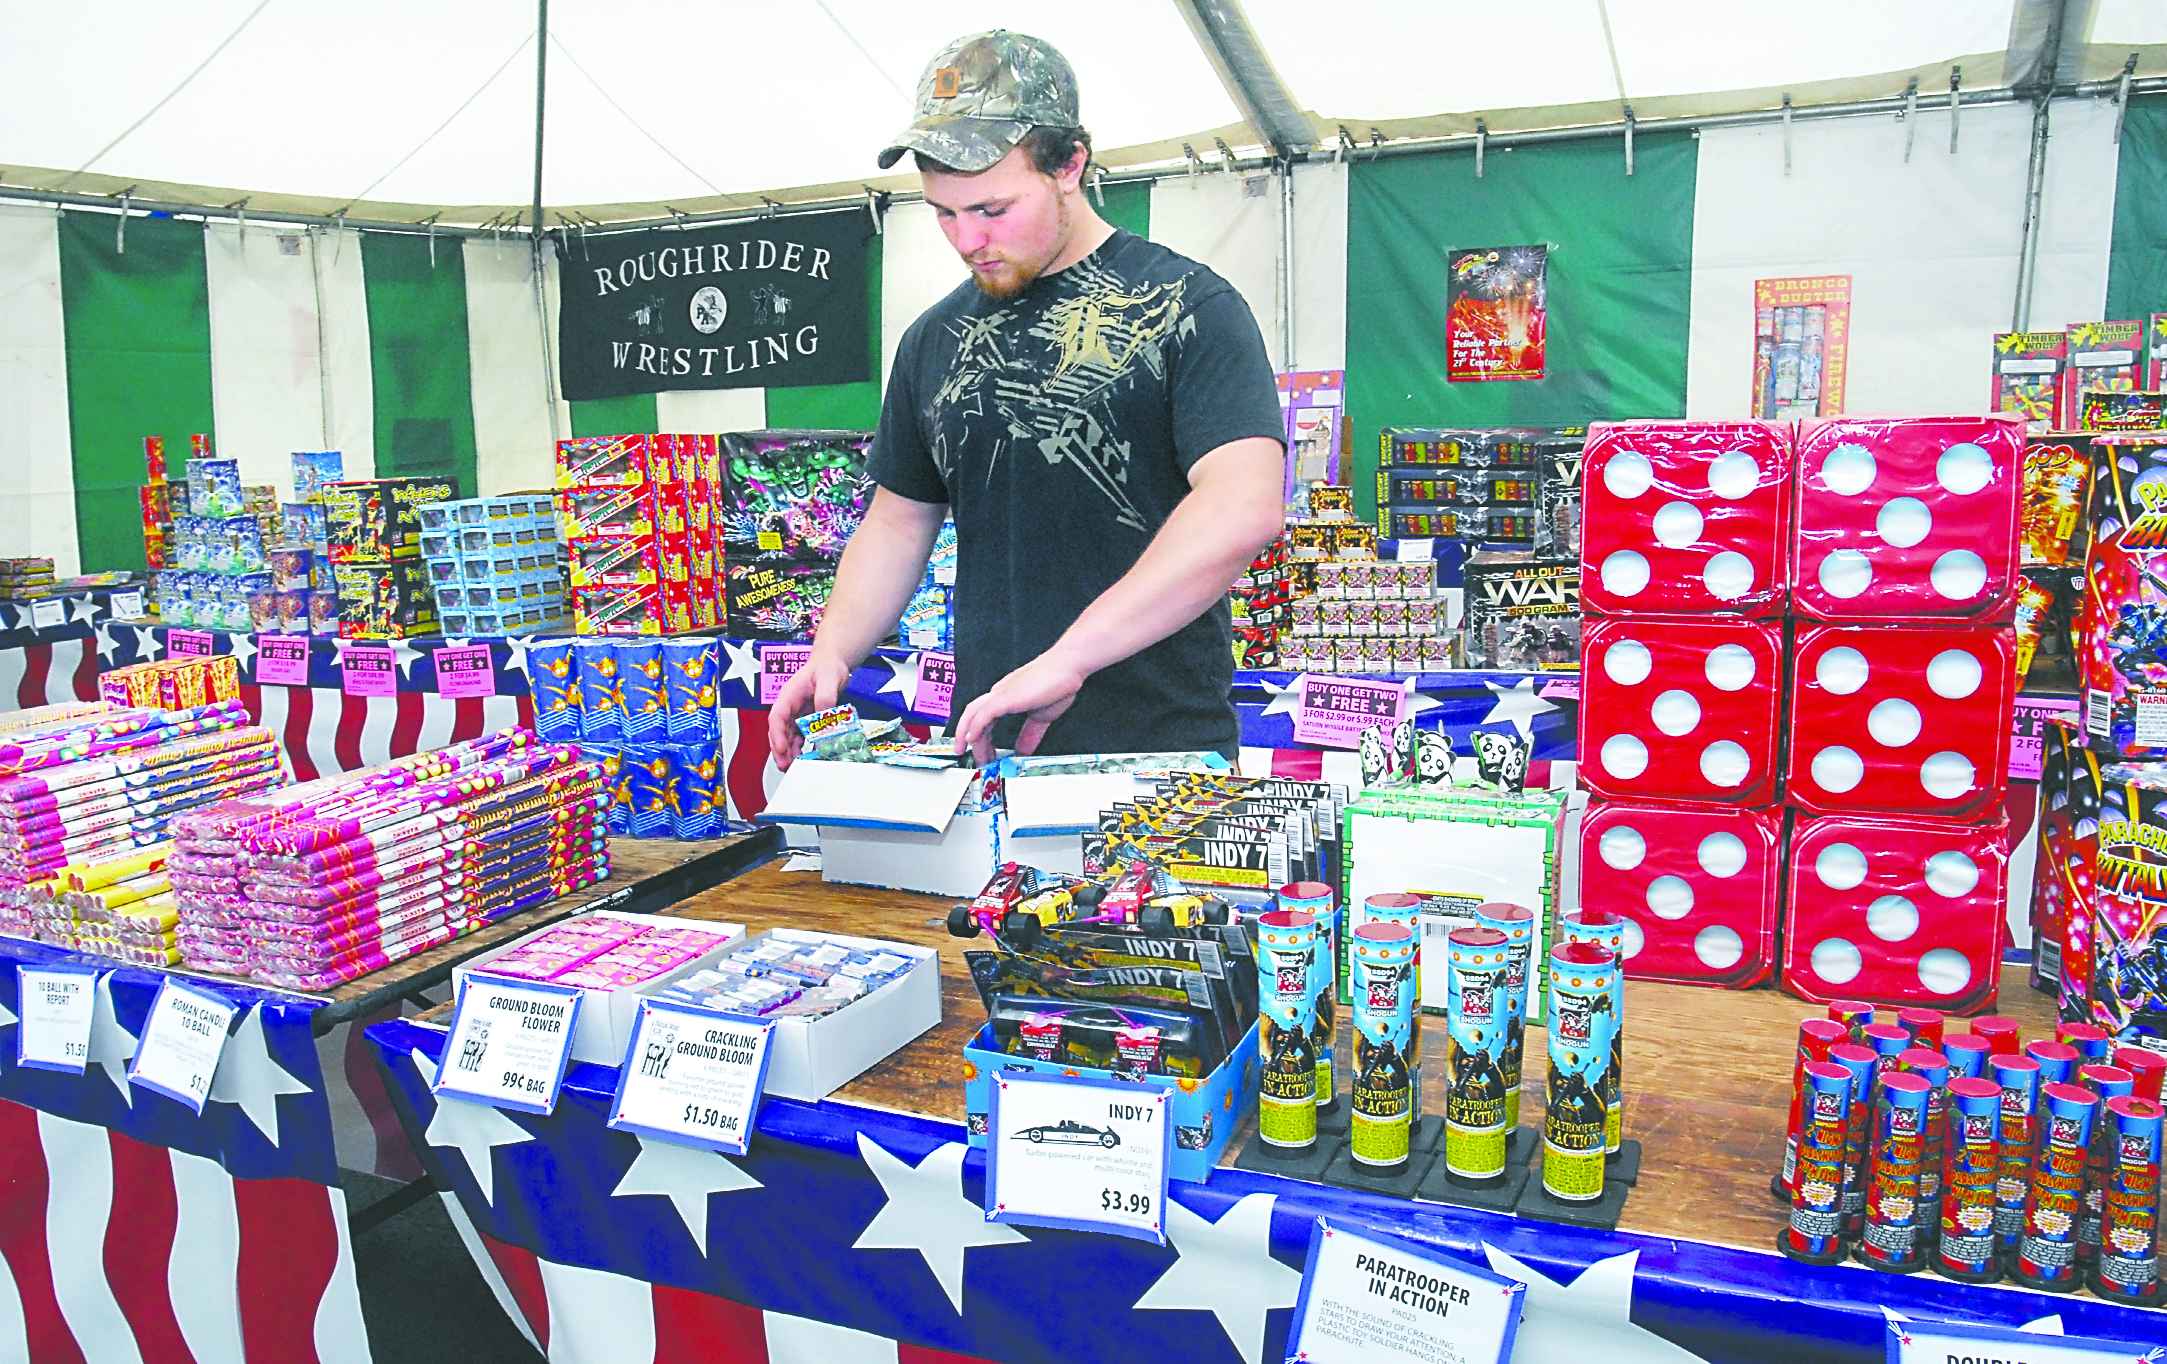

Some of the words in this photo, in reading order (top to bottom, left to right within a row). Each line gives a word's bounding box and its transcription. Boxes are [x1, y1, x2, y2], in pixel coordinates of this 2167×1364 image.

[594, 239, 831, 295] ROUGHRIDER
[1775, 278, 1848, 291] BRONCO
[1780, 292, 1846, 303] BUSTER
[2093, 324, 2139, 333] TIMBER
[2101, 333, 2132, 342] WOLF
[612, 325, 819, 376] WRESTLING
[1453, 340, 1485, 348] Reliable
[1469, 359, 1504, 367] Century
[1826, 344, 1845, 416] FIREWO
[2024, 443, 2074, 473] GOD
[392, 484, 451, 503] WHO'S
[748, 569, 776, 590] PURE
[1515, 568, 1537, 579] ALL
[1539, 567, 1564, 577] OUT
[735, 578, 796, 609] AWESOMENESS
[1483, 576, 1579, 606] WAR
[1509, 605, 1532, 614] 500
[1533, 604, 1568, 613] GRAM
[182, 643, 200, 653] FREE
[273, 649, 292, 658] FREE
[766, 653, 781, 661] BUY
[782, 652, 799, 660] ONE
[357, 661, 378, 670] FREE
[453, 660, 474, 671] FREE
[783, 661, 805, 673] FRE
[926, 658, 943, 668] BUY
[1308, 683, 1329, 693] BUY
[1330, 686, 1350, 696] ONE
[1352, 688, 1372, 698] GET
[1373, 690, 1396, 700] TWO
[1330, 696, 1370, 712] FREE
[1310, 710, 1324, 720] FOR
[1326, 712, 1345, 722] $2.99
[1374, 718, 1394, 726] EACH
[466, 807, 512, 830] Candle
[1204, 841, 1250, 867] INDY
[1255, 845, 1268, 869] 7
[1125, 938, 1176, 958] INDY
[1183, 942, 1195, 961] 7
[38, 981, 46, 992] 10
[47, 982, 62, 992] BALL
[63, 983, 80, 995] WITH
[46, 994, 69, 1006] REPORT
[490, 997, 528, 1012] GROUND
[530, 1002, 564, 1018] BLOOM
[171, 998, 198, 1019] ROMAN
[199, 1009, 226, 1028] CANDLE
[1366, 1009, 1397, 1017] SHOGUN
[182, 1016, 190, 1028] 10
[192, 1020, 210, 1036] BALL
[522, 1016, 560, 1033] FLOWER
[704, 1030, 757, 1050] CRACKLING
[1556, 1036, 1589, 1049] SHOGUN
[66, 1043, 85, 1057] $1.50
[677, 1041, 717, 1059] GROUND
[719, 1048, 753, 1065] BLOOM
[502, 1072, 524, 1088] 99¢
[527, 1079, 545, 1093] BAG
[1109, 1104, 1143, 1120] INDY
[1146, 1109, 1153, 1122] 7
[1354, 1094, 1365, 1109] IN
[1367, 1097, 1406, 1115] ACTION
[684, 1103, 718, 1126] $1.50
[720, 1116, 738, 1130] BAG
[1026, 1149, 1046, 1157] Turbo
[1048, 1151, 1080, 1160] powered
[1096, 1155, 1111, 1163] with
[1114, 1157, 1138, 1167] whistle
[1095, 1164, 1133, 1175] multi-color
[1102, 1188, 1150, 1215] $3.99
[1355, 1254, 1471, 1306] PARATROOPER
[1368, 1277, 1387, 1296] IN
[1389, 1285, 1449, 1318] ACTION
[1322, 1298, 1344, 1313] WITH
[1344, 1306, 1360, 1319] THE
[1362, 1311, 1393, 1329] SOUND
[1394, 1323, 1405, 1332] OF
[1408, 1327, 1454, 1350] CRACKLING
[1392, 1308, 1417, 1322] PA025
[1316, 1326, 1365, 1348] PARACHUTE.
[1318, 1316, 1351, 1333] PLASTIC
[1352, 1327, 1368, 1339] TOY
[1369, 1333, 1404, 1350] SOLDIER
[1406, 1345, 1436, 1361] HANGS
[1320, 1307, 1344, 1322] STARS
[1346, 1316, 1357, 1326] TO
[1358, 1320, 1384, 1335] DRAW
[1385, 1329, 1408, 1344] YOUR
[1410, 1337, 1458, 1362] ATTENTION,
